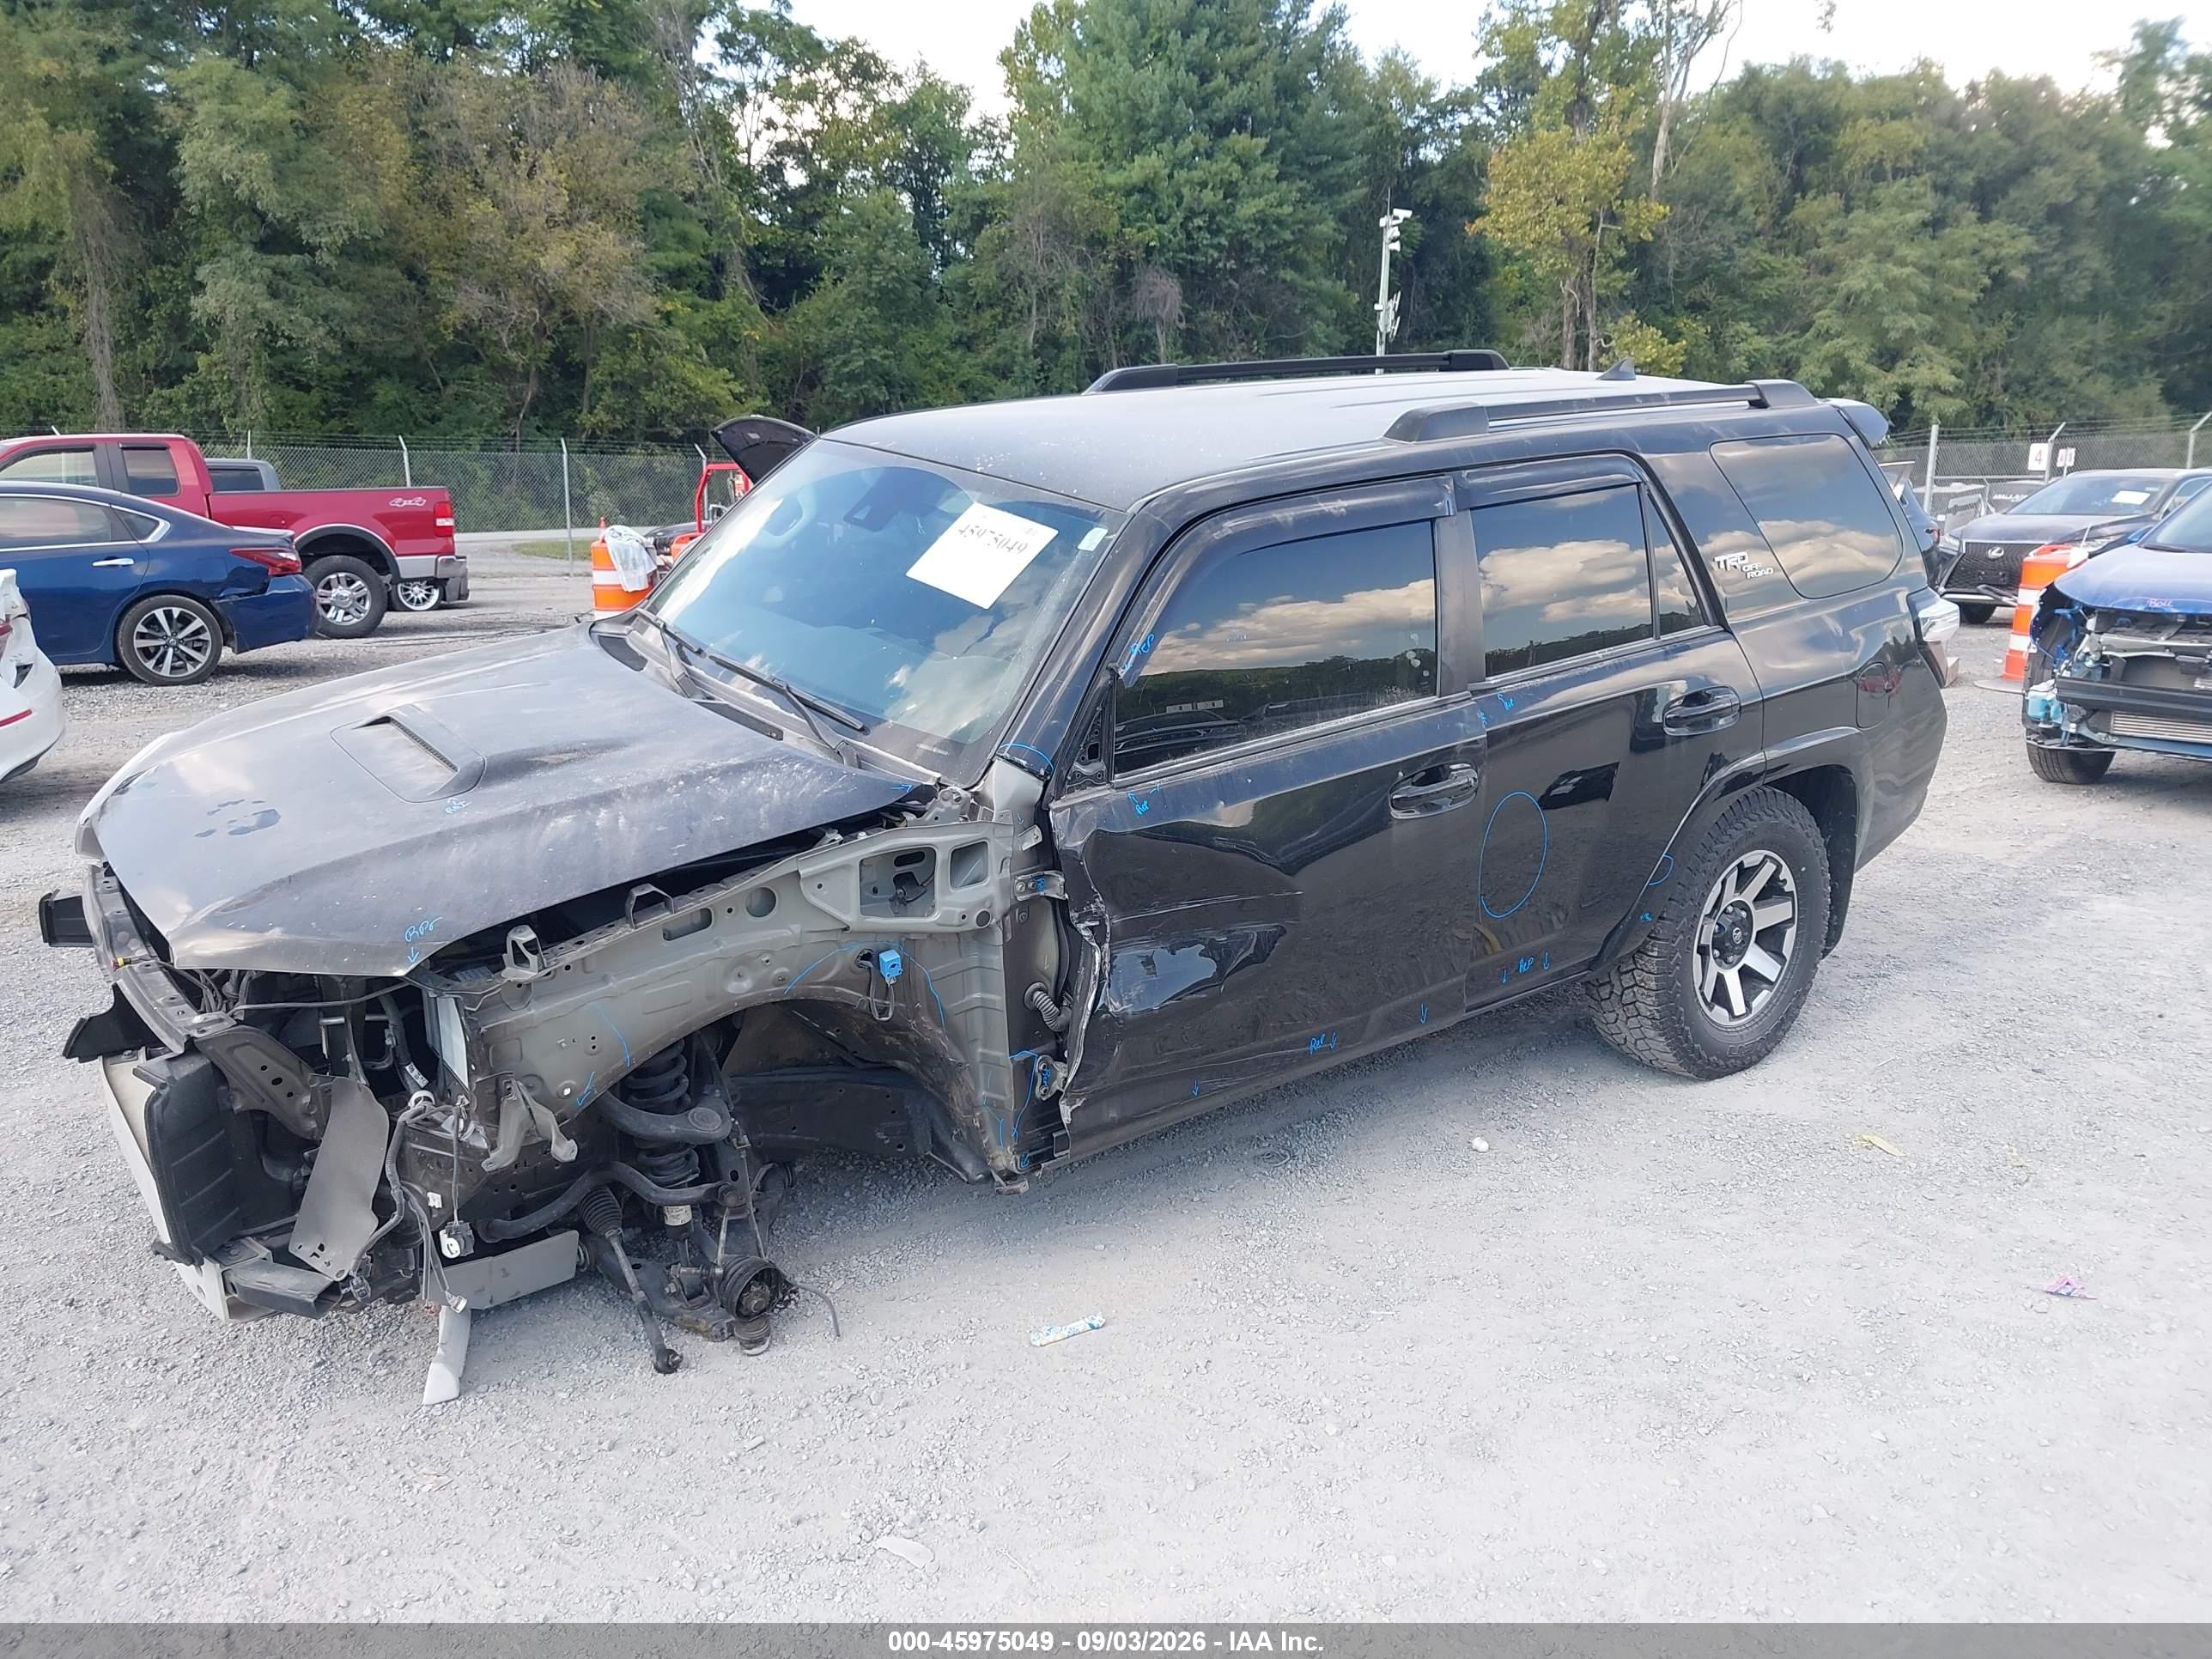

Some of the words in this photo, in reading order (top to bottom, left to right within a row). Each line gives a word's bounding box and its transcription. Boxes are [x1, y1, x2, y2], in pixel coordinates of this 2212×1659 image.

[2034, 449, 2042, 465] 4
[958, 524, 1029, 555] 4595049
[1712, 551, 1749, 573] TRD
[1747, 568, 1774, 579] ROAD
